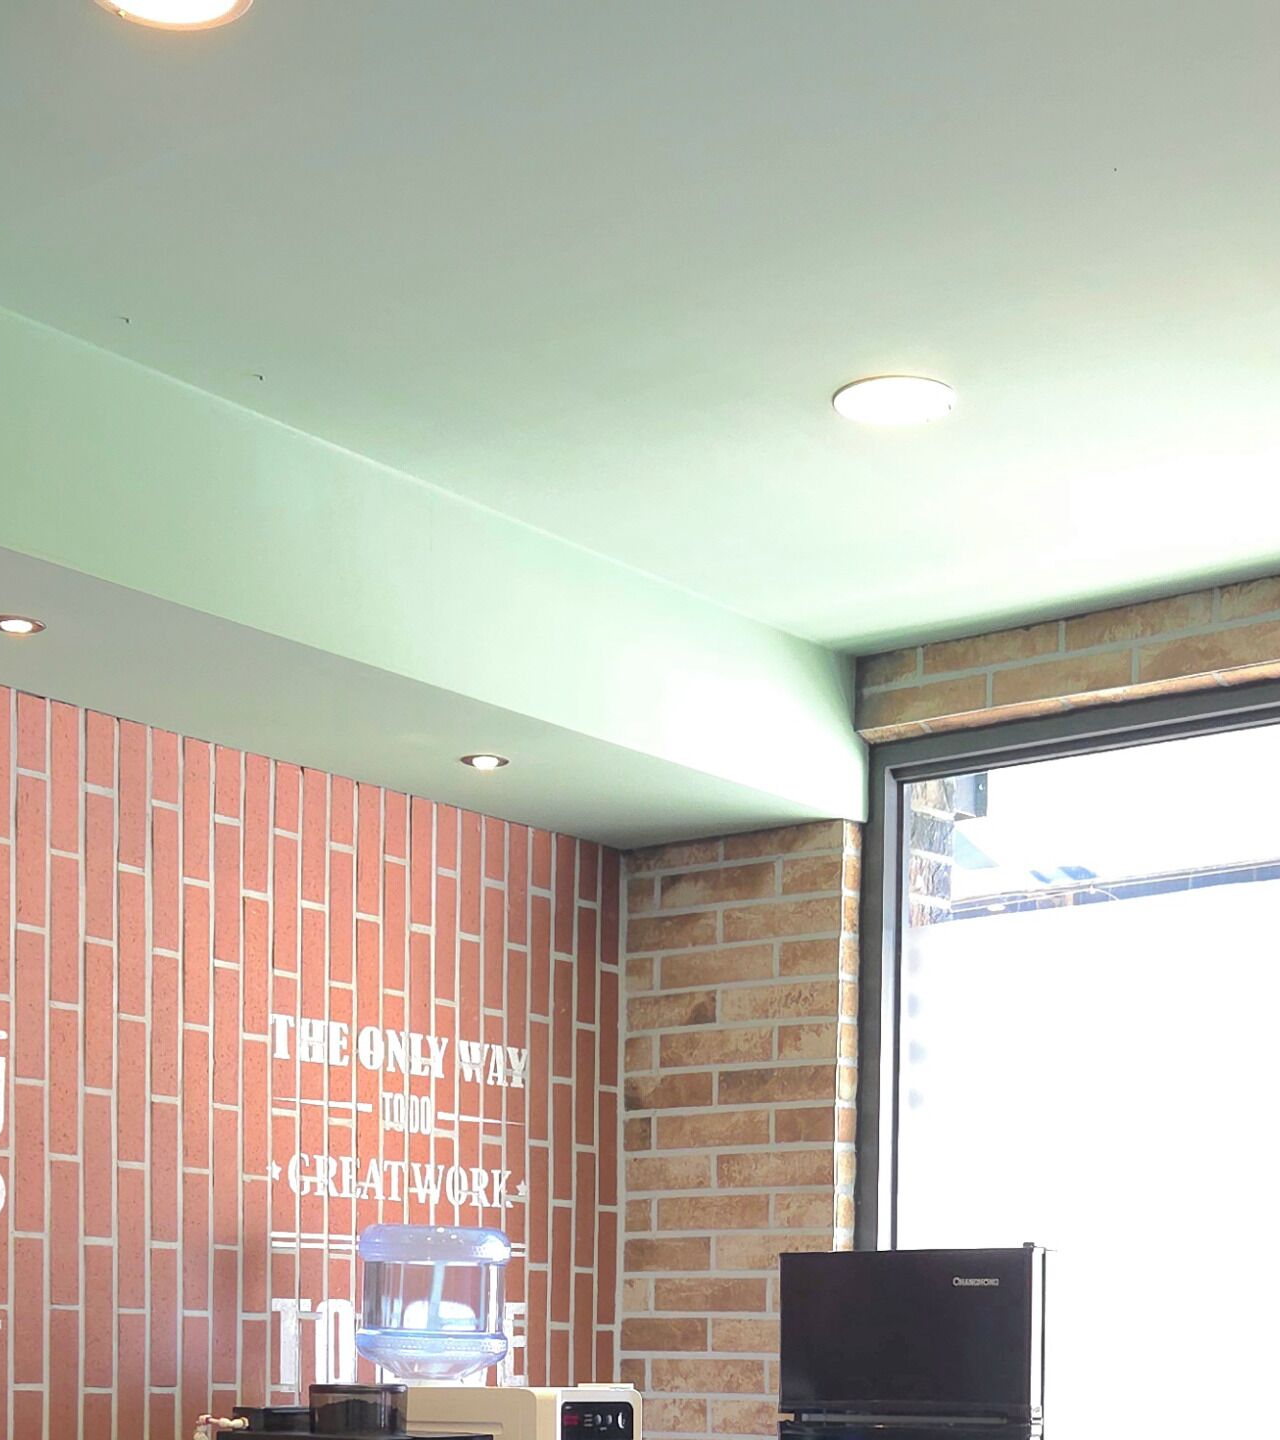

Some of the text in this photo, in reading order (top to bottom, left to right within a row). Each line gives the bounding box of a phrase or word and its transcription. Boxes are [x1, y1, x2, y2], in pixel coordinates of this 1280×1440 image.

[270, 1013, 529, 1089] THE ONLY WAY
[287, 1153, 514, 1209] GREAT WORK
